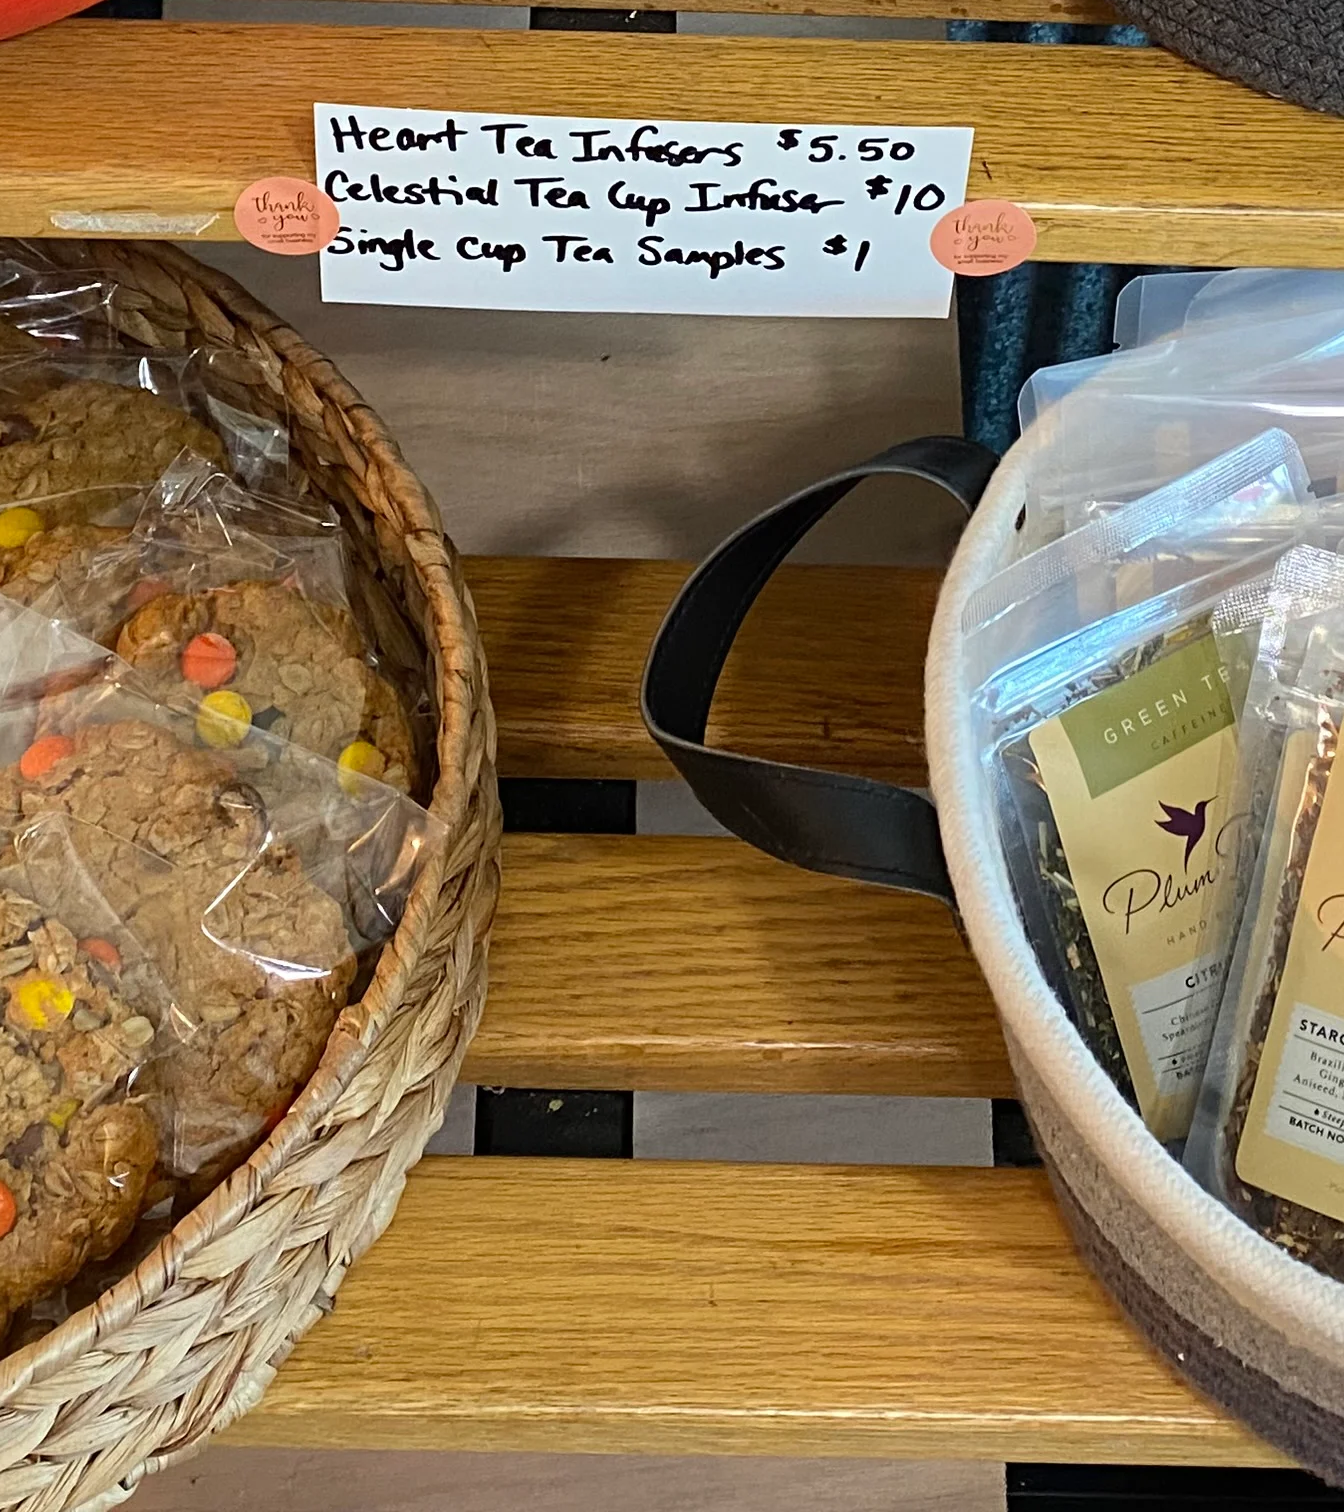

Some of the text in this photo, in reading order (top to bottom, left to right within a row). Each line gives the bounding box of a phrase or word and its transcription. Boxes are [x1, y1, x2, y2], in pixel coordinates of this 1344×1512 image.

[330, 115, 468, 153] Heart
[480, 123, 559, 160] Tea
[777, 129, 915, 164] $5.50
[251, 191, 315, 213] thank
[324, 169, 946, 227] Celestial Tea Cup Infuser $10
[272, 213, 308, 232] you
[952, 211, 1014, 235] thank
[327, 226, 871, 279] Single Cup Tea Samples $1
[967, 235, 1004, 251] you
[1104, 689, 1188, 744] GREEN
[1103, 869, 1216, 935] Plum
[1166, 919, 1208, 945] HAND
[1293, 1074, 1338, 1098] Aniseed,
[1289, 1116, 1324, 1137] BATCH
